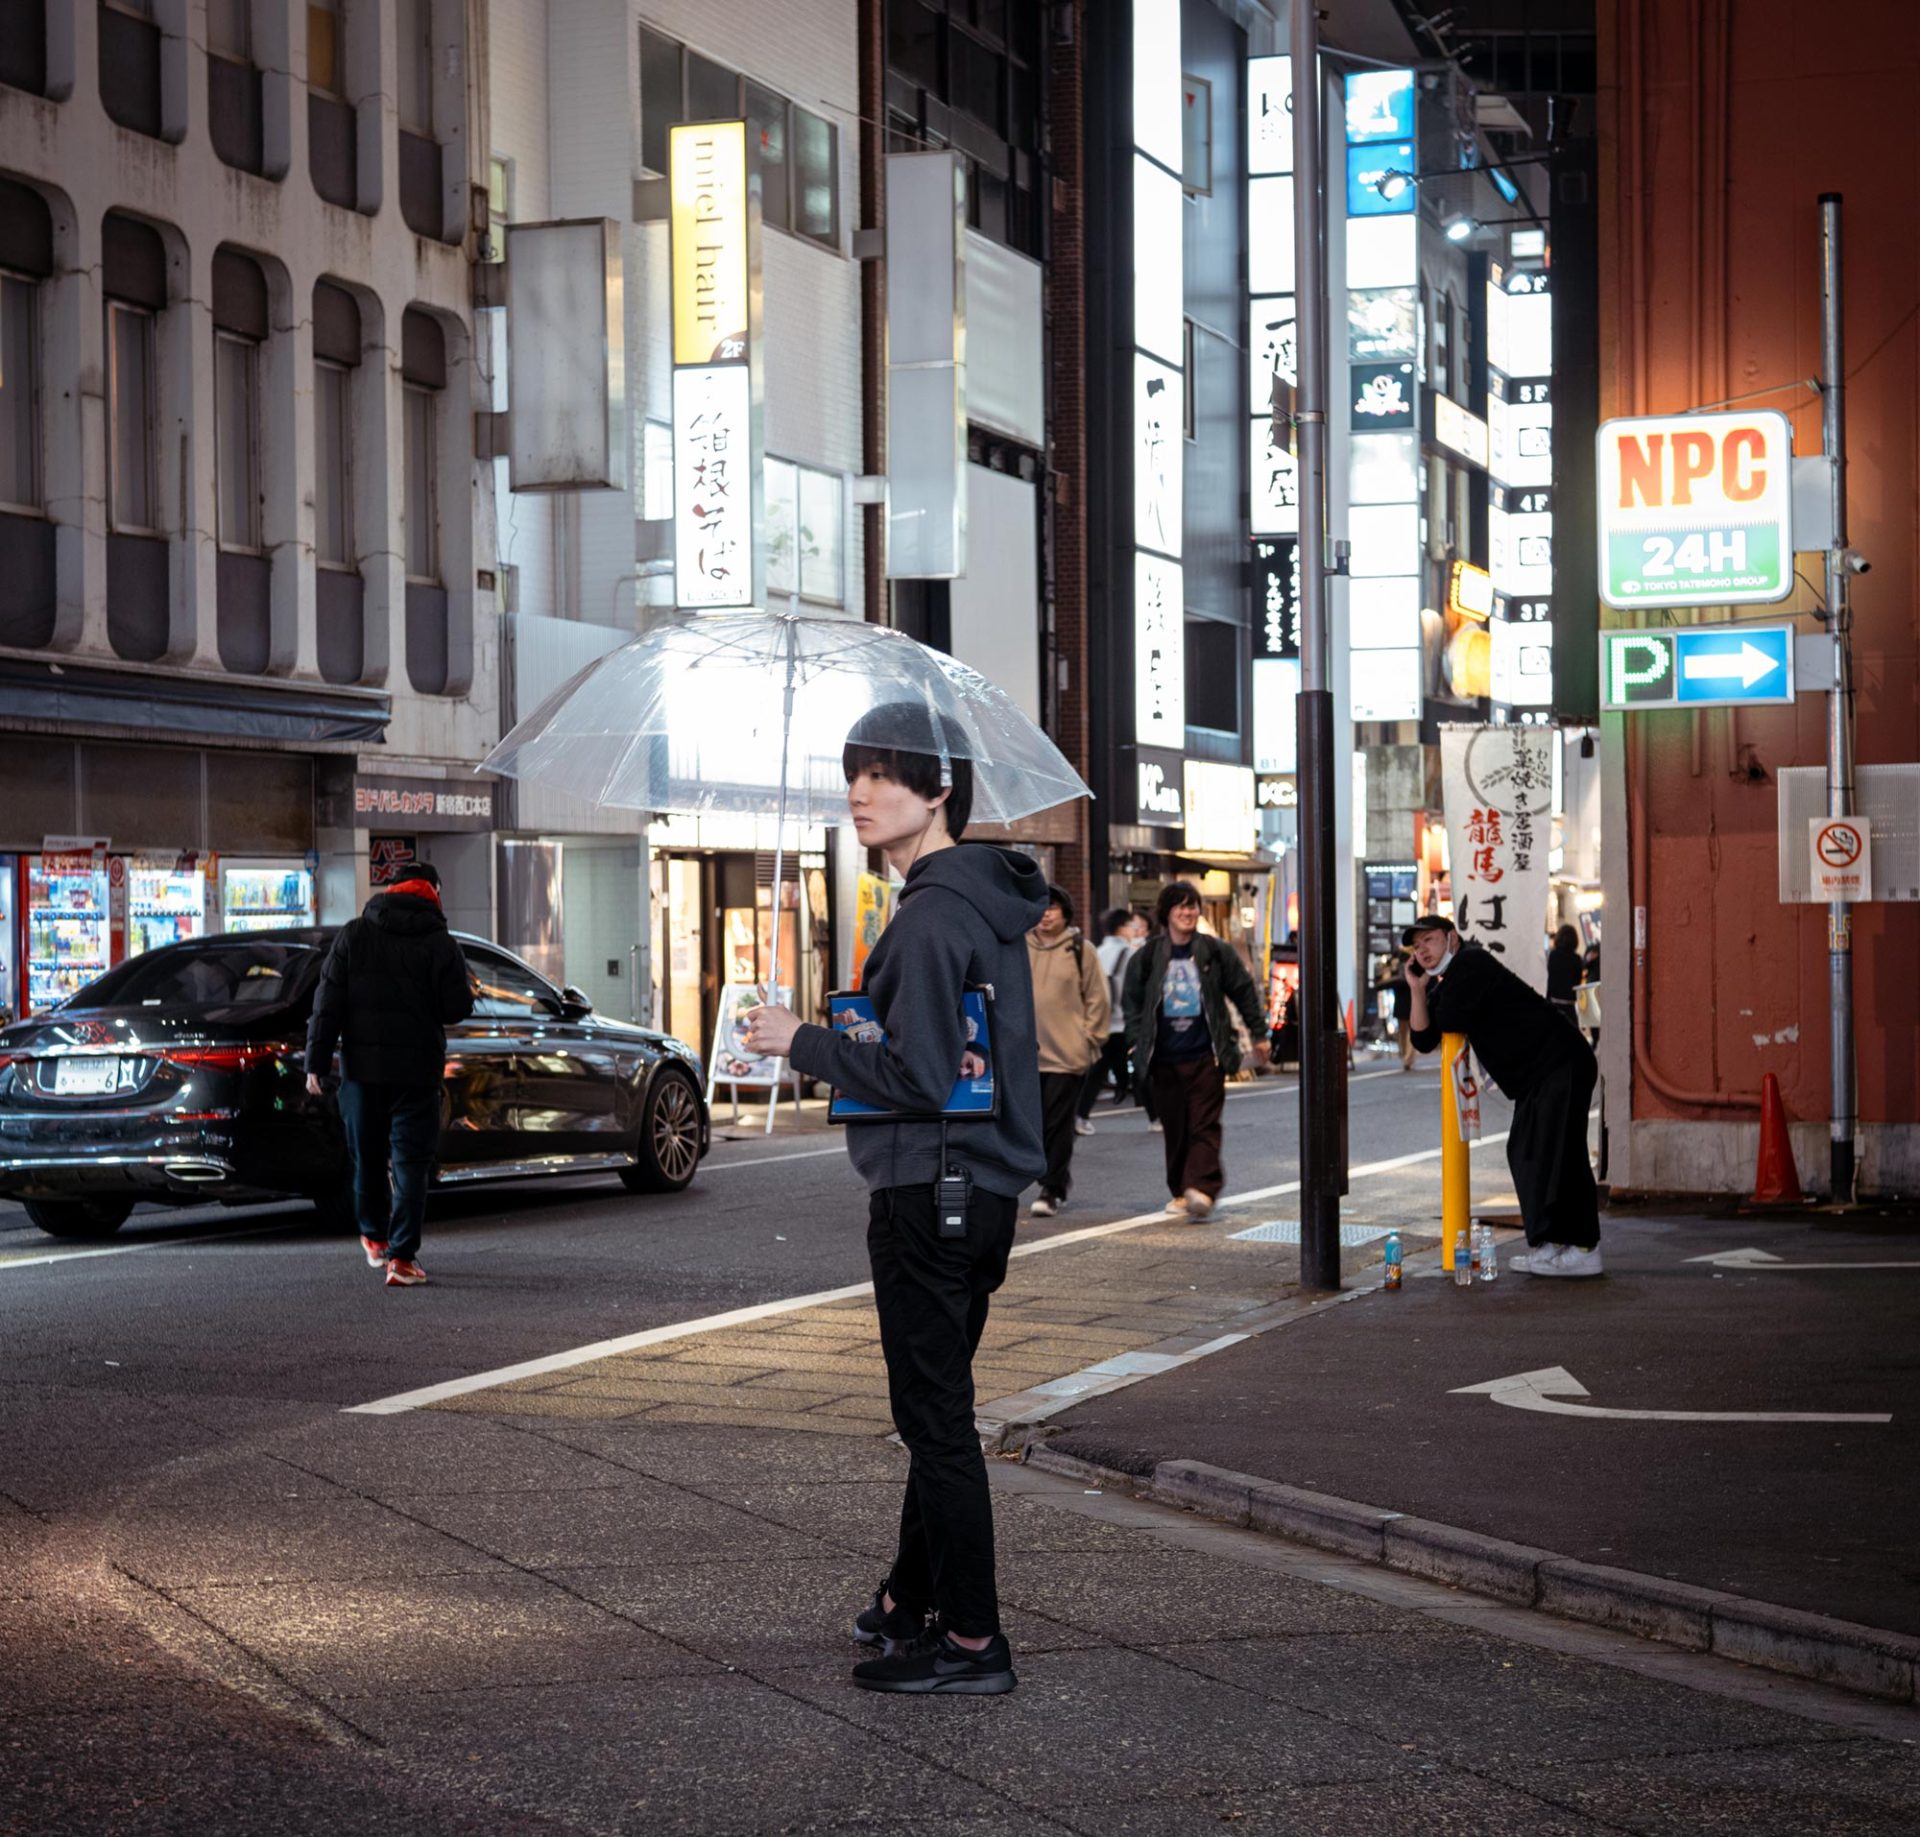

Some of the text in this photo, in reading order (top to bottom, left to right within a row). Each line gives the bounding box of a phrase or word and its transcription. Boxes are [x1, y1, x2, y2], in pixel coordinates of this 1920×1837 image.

[696, 141, 725, 331] miel hair
[720, 339, 744, 358] 2F
[1520, 384, 1549, 403] 5F
[1618, 427, 1767, 509] NPC
[1519, 493, 1549, 512] 4F
[1641, 529, 1747, 577] 24H
[1643, 575, 1769, 592] TOKYO TATEMONO GROUP
[1520, 603, 1549, 621] 3F
[1611, 636, 1670, 705] P
[355, 788, 492, 817] ヨドバシカメラ 新宿西口本店
